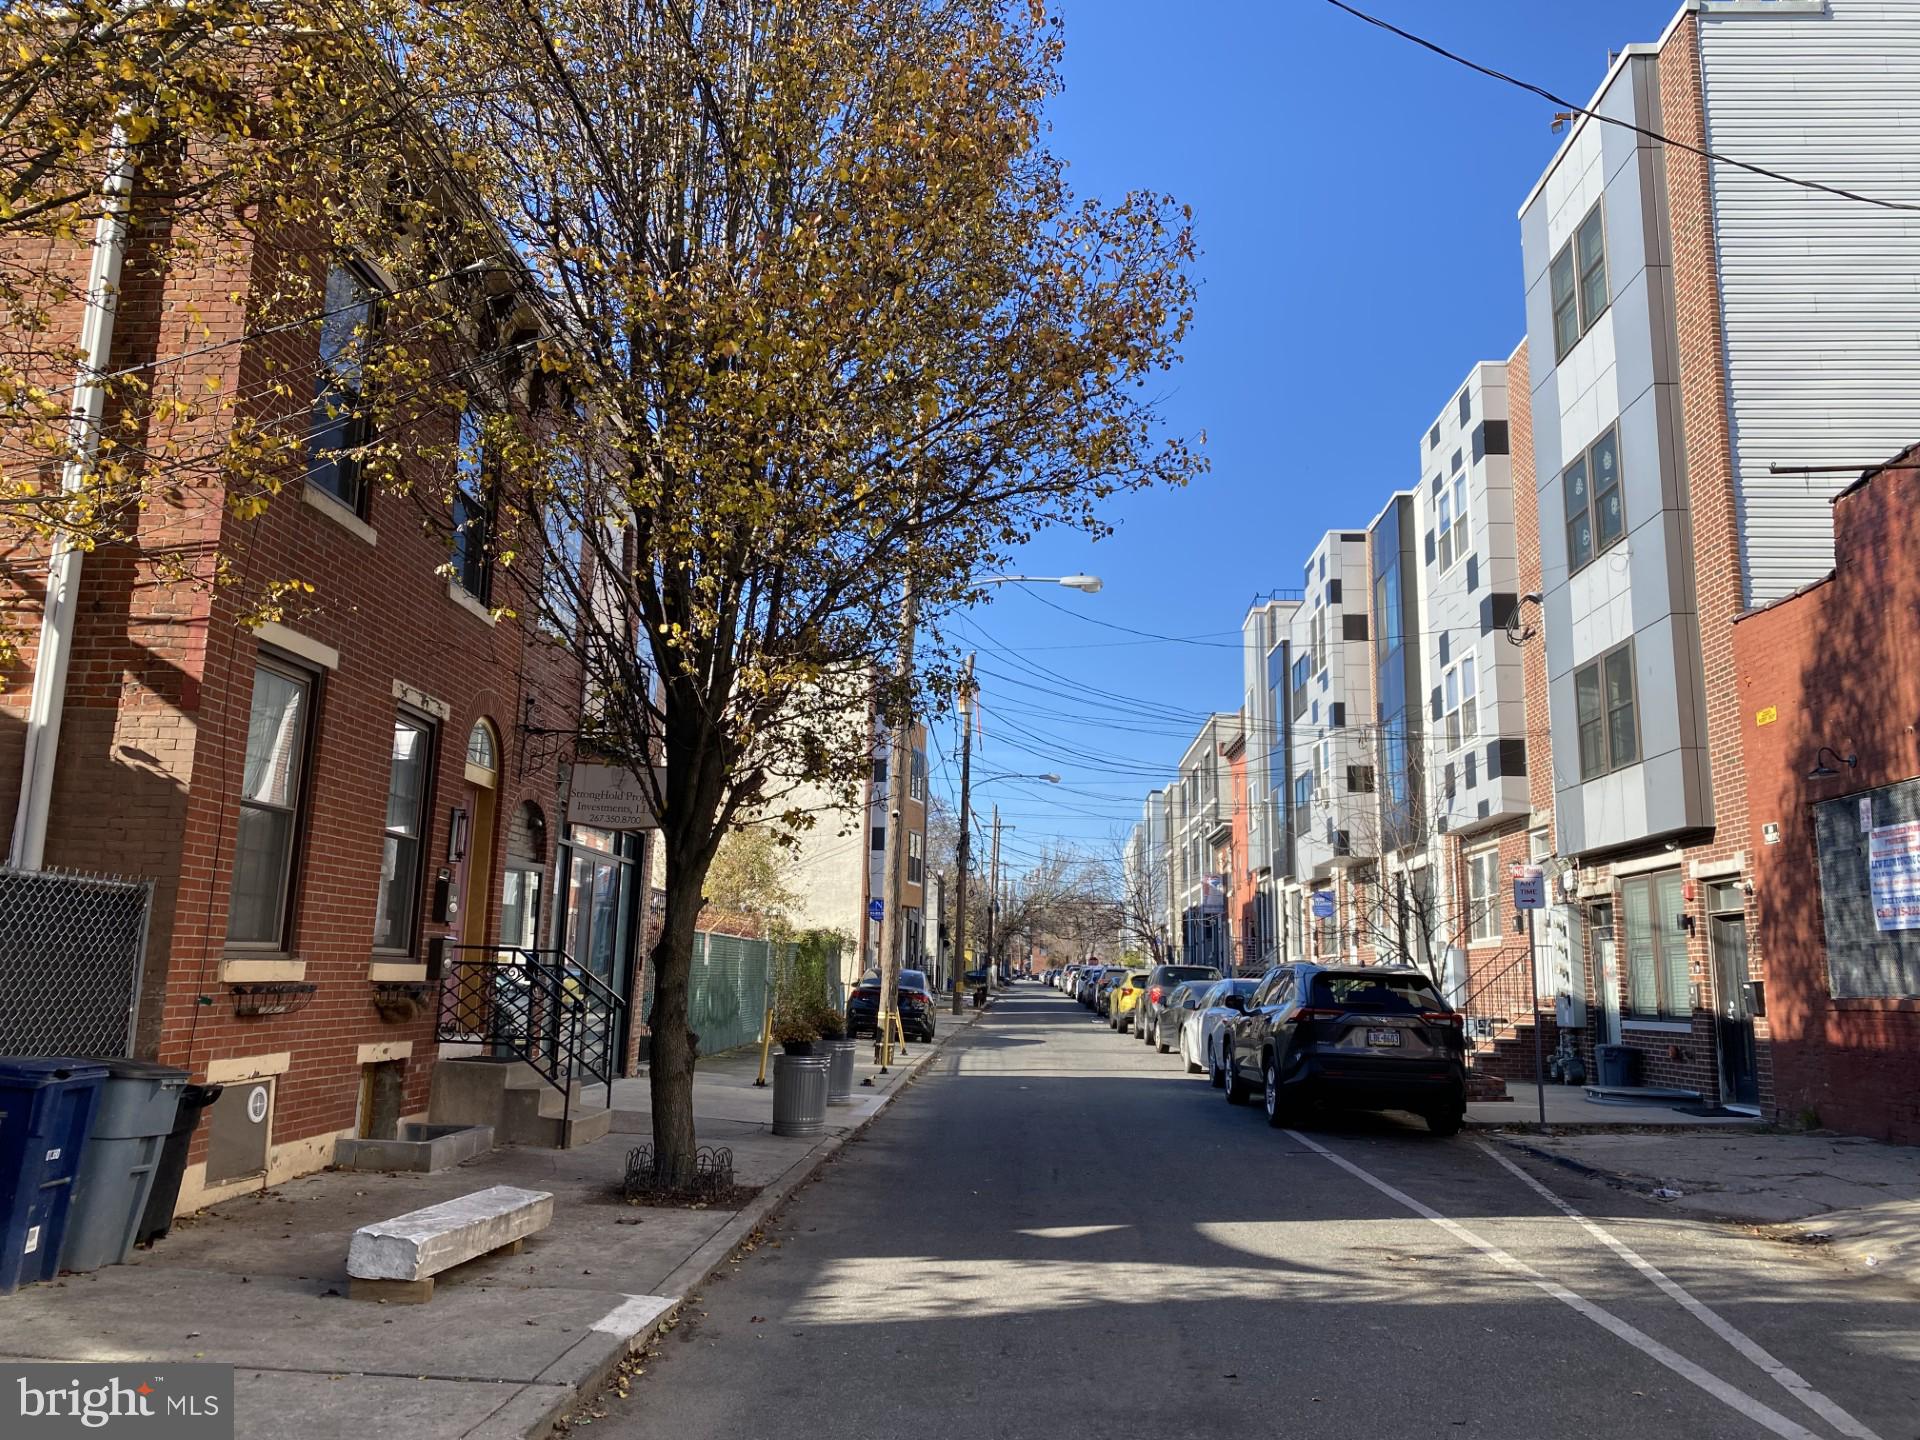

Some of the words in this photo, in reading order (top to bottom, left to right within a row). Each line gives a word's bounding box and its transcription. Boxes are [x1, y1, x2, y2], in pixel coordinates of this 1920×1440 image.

[570, 788, 624, 802] StrongHold
[577, 801, 633, 814] Investments,
[590, 813, 641, 825] 267.350.8700
